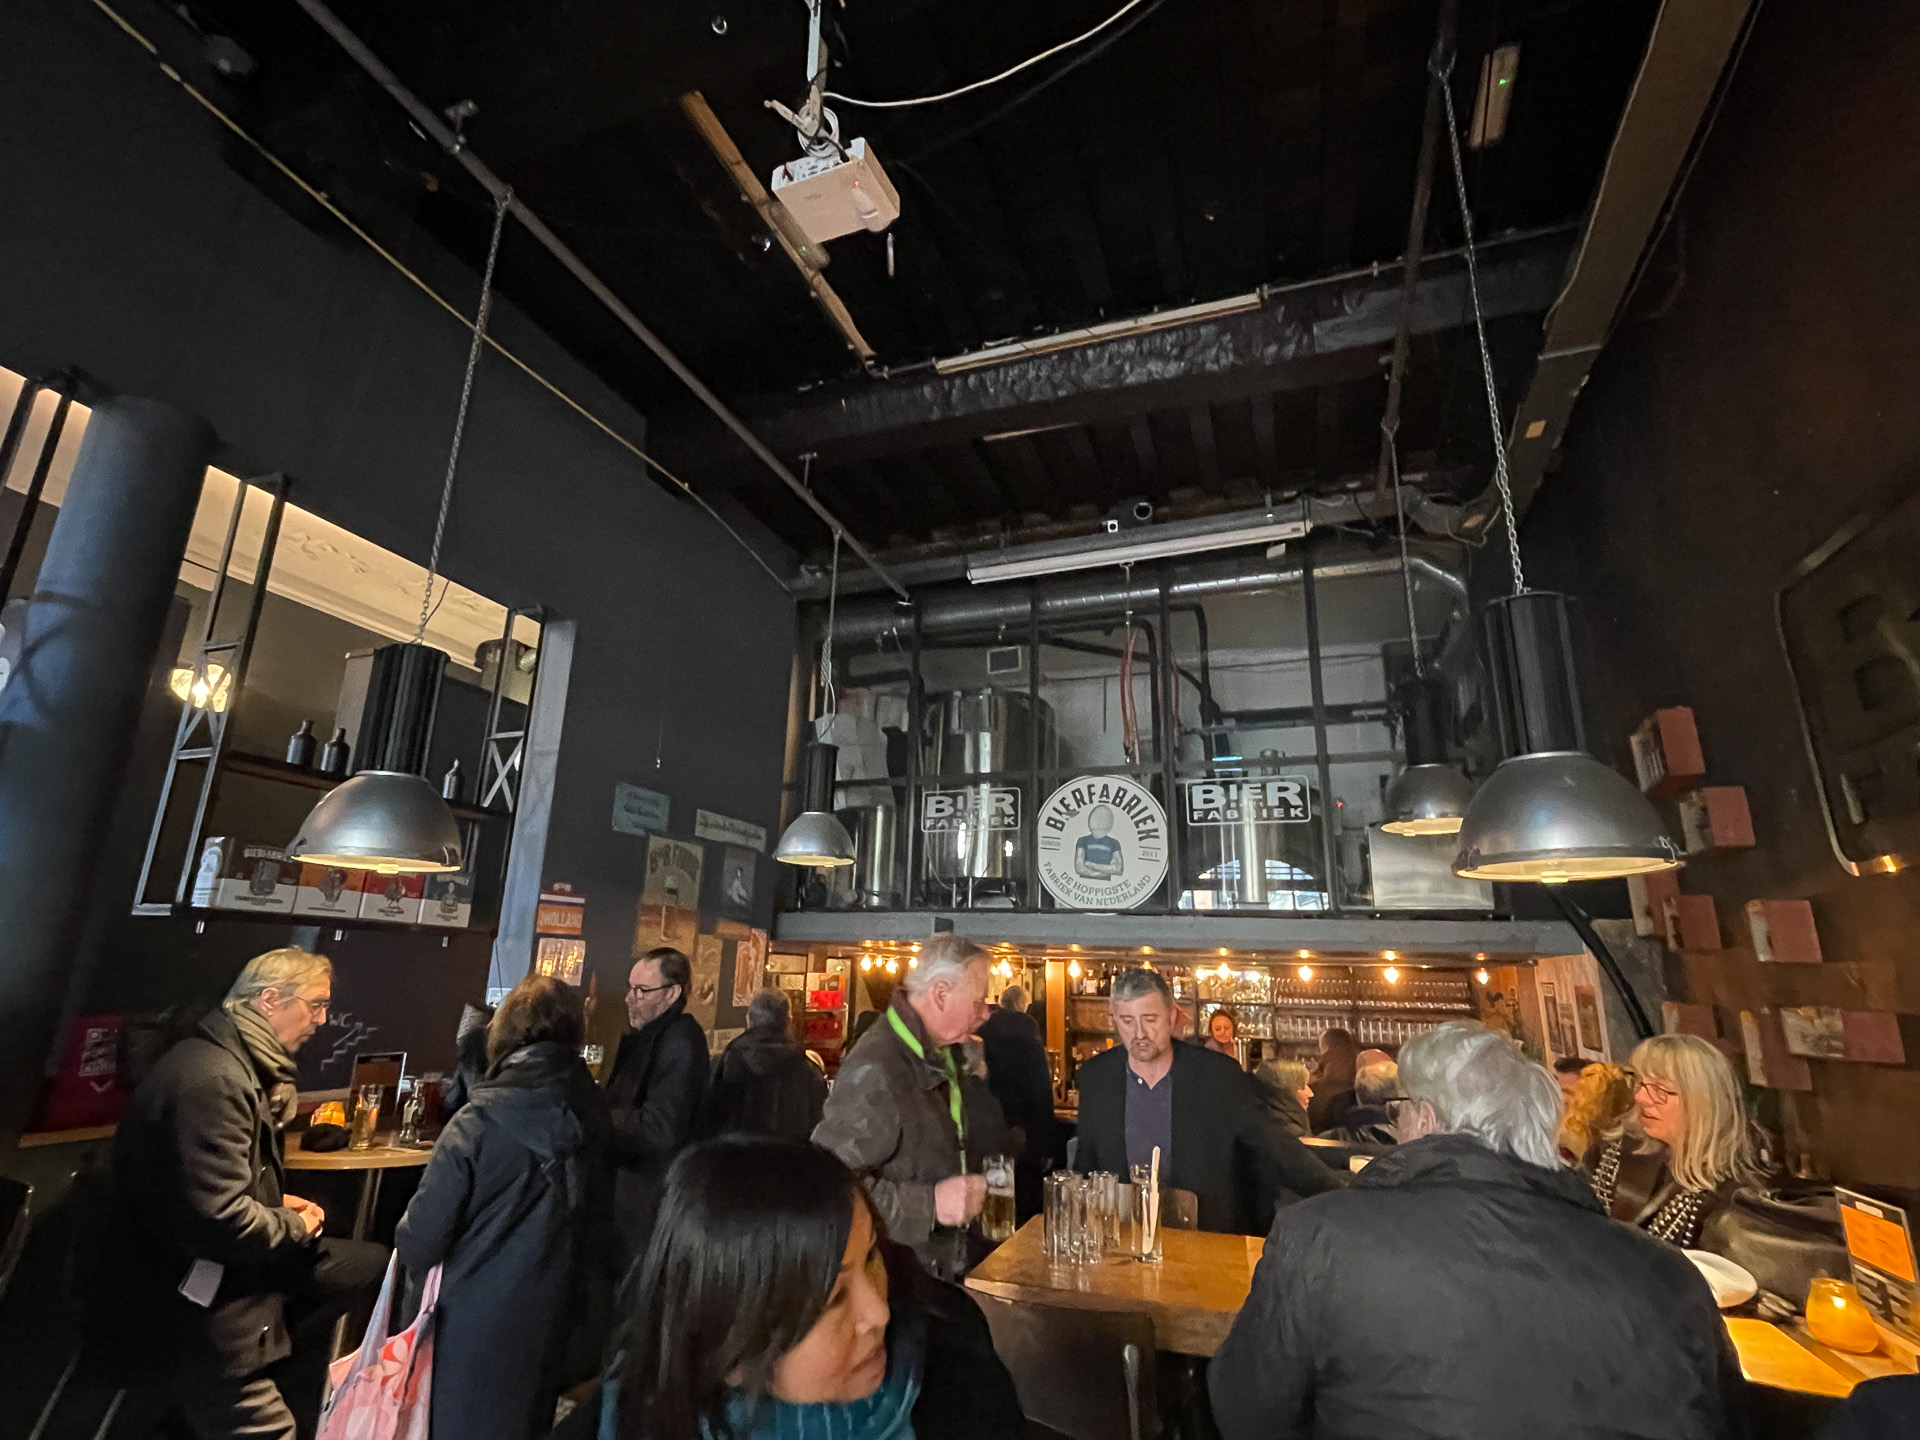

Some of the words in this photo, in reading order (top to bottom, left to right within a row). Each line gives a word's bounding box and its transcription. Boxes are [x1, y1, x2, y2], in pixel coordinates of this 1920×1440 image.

[926, 793, 1015, 817] BIER
[1192, 781, 1303, 809] BIER
[1045, 783, 1160, 842] BIERFABRIEK
[1141, 850, 1158, 858] 2011
[1043, 861, 1073, 897] FABRIEK
[1074, 892, 1094, 906] VAN
[1095, 874, 1151, 906] NEDERLAND
[1060, 872, 1074, 886] DE
[1073, 879, 1132, 897] HOPPIGSTE
[329, 1012, 353, 1028] WC
